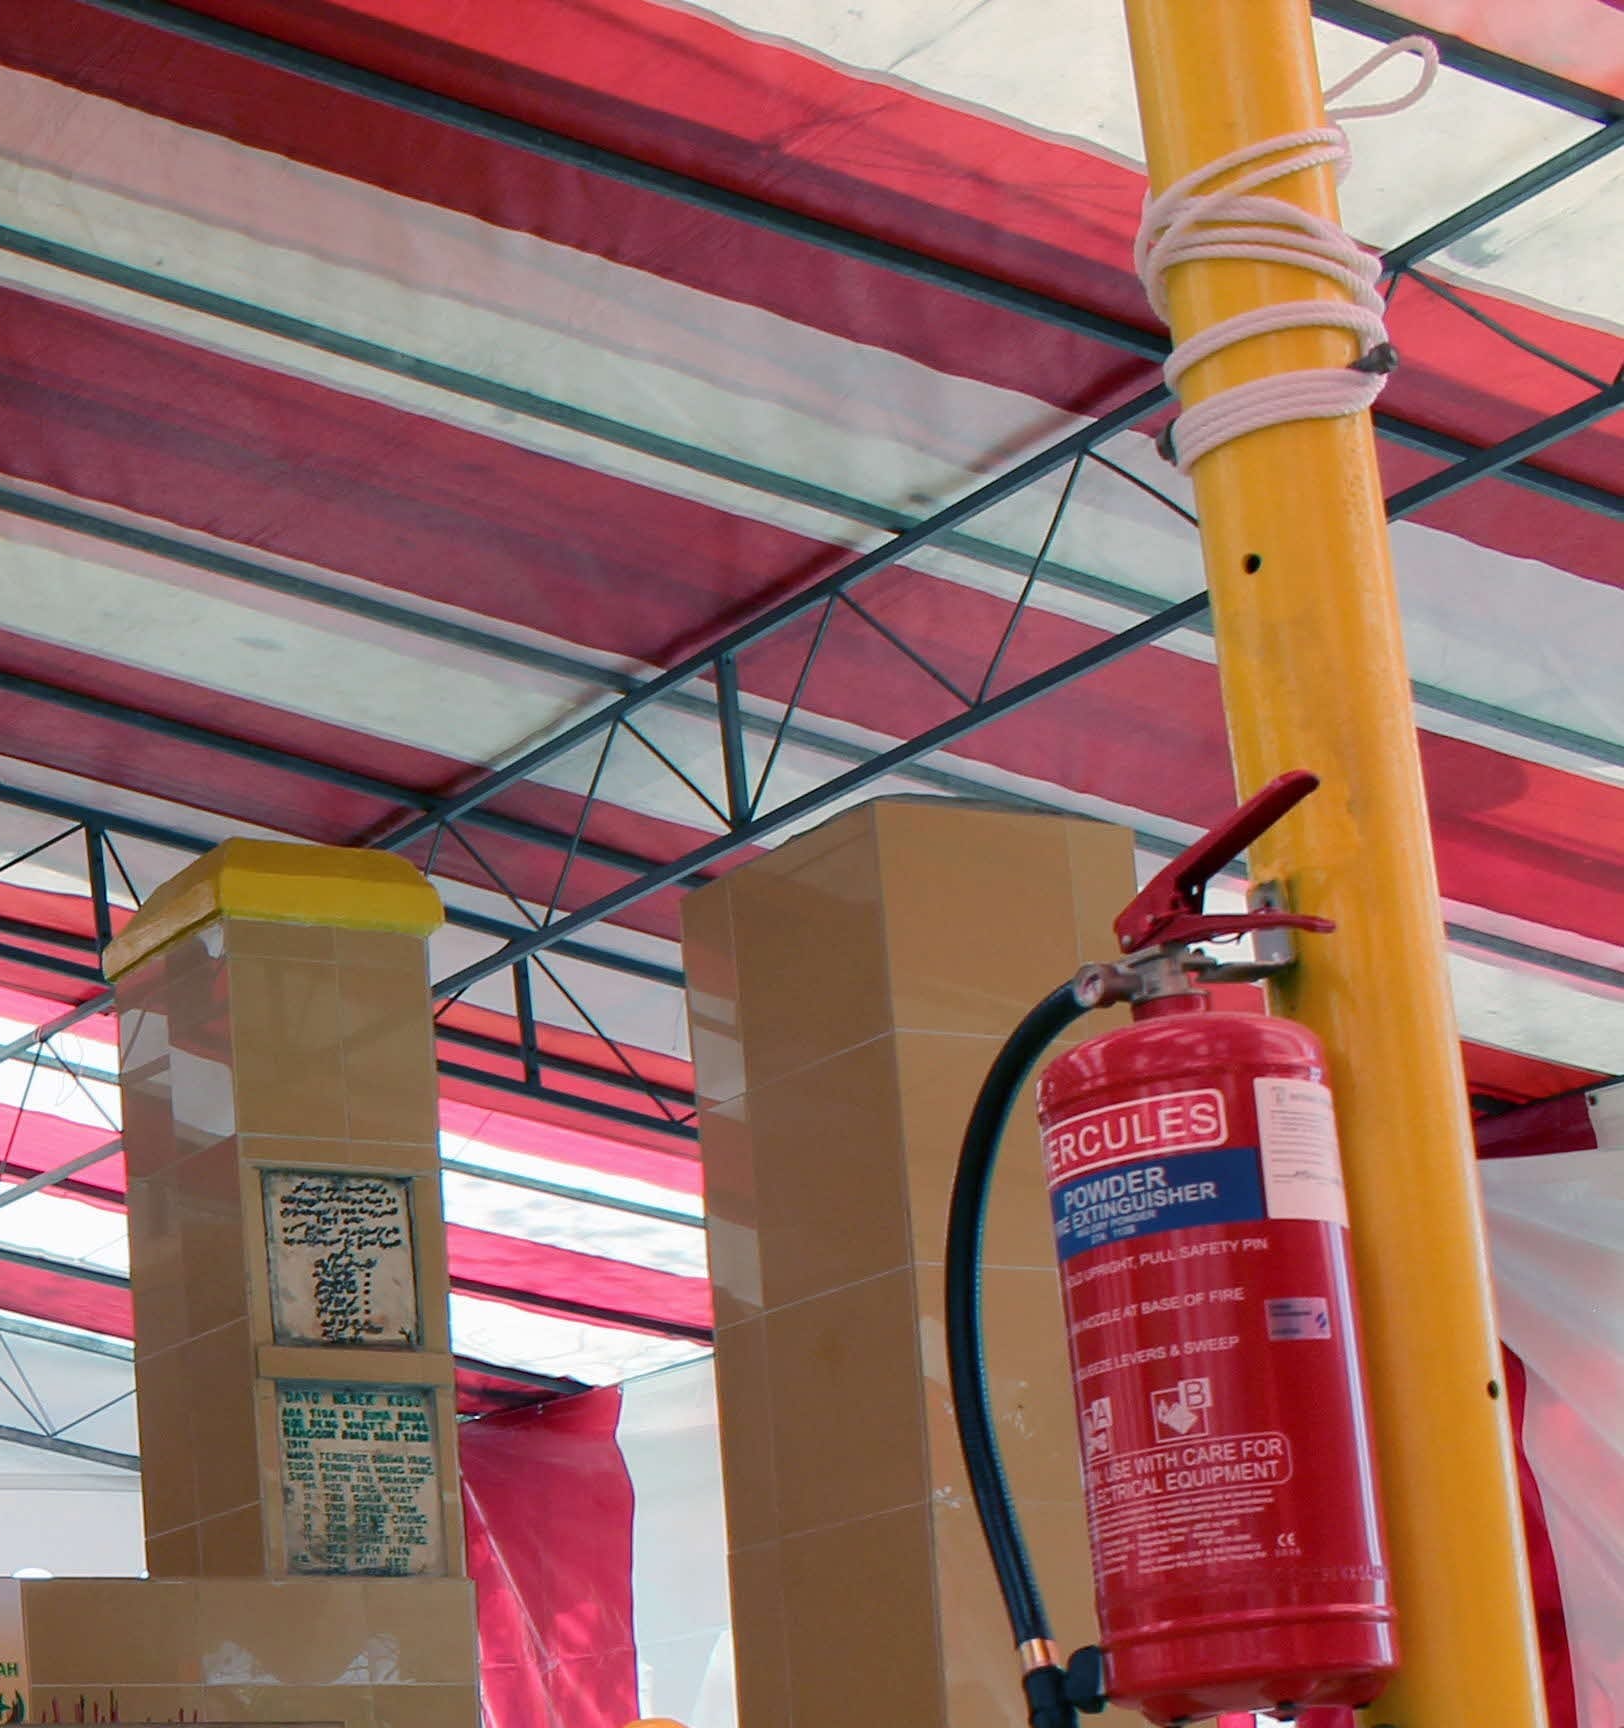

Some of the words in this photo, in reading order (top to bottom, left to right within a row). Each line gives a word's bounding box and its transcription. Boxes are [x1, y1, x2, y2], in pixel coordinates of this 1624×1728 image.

[1045, 1102, 1219, 1173] ERCULES
[1064, 1166, 1167, 1214] POWDER
[1072, 1181, 1217, 1230] EXTINGUISHER
[1139, 1250, 1175, 1266] PULL
[1179, 1239, 1240, 1260] SAFETY
[1241, 1237, 1269, 1251] PIN
[1122, 1303, 1138, 1318] AT
[1141, 1296, 1182, 1314] BASE
[1185, 1291, 1205, 1306] OF
[1208, 1287, 1246, 1303] FIRE
[1115, 1345, 1168, 1369] LEVERS
[1169, 1343, 1180, 1357] &
[1183, 1336, 1240, 1355] SWEEP
[1184, 1380, 1205, 1406] B
[1104, 1459, 1132, 1483] USE
[1134, 1452, 1178, 1475] WITH
[1181, 1442, 1237, 1467] CARE
[1241, 1436, 1284, 1458] FOR
[1164, 1459, 1280, 1491] EQUIPMENT
